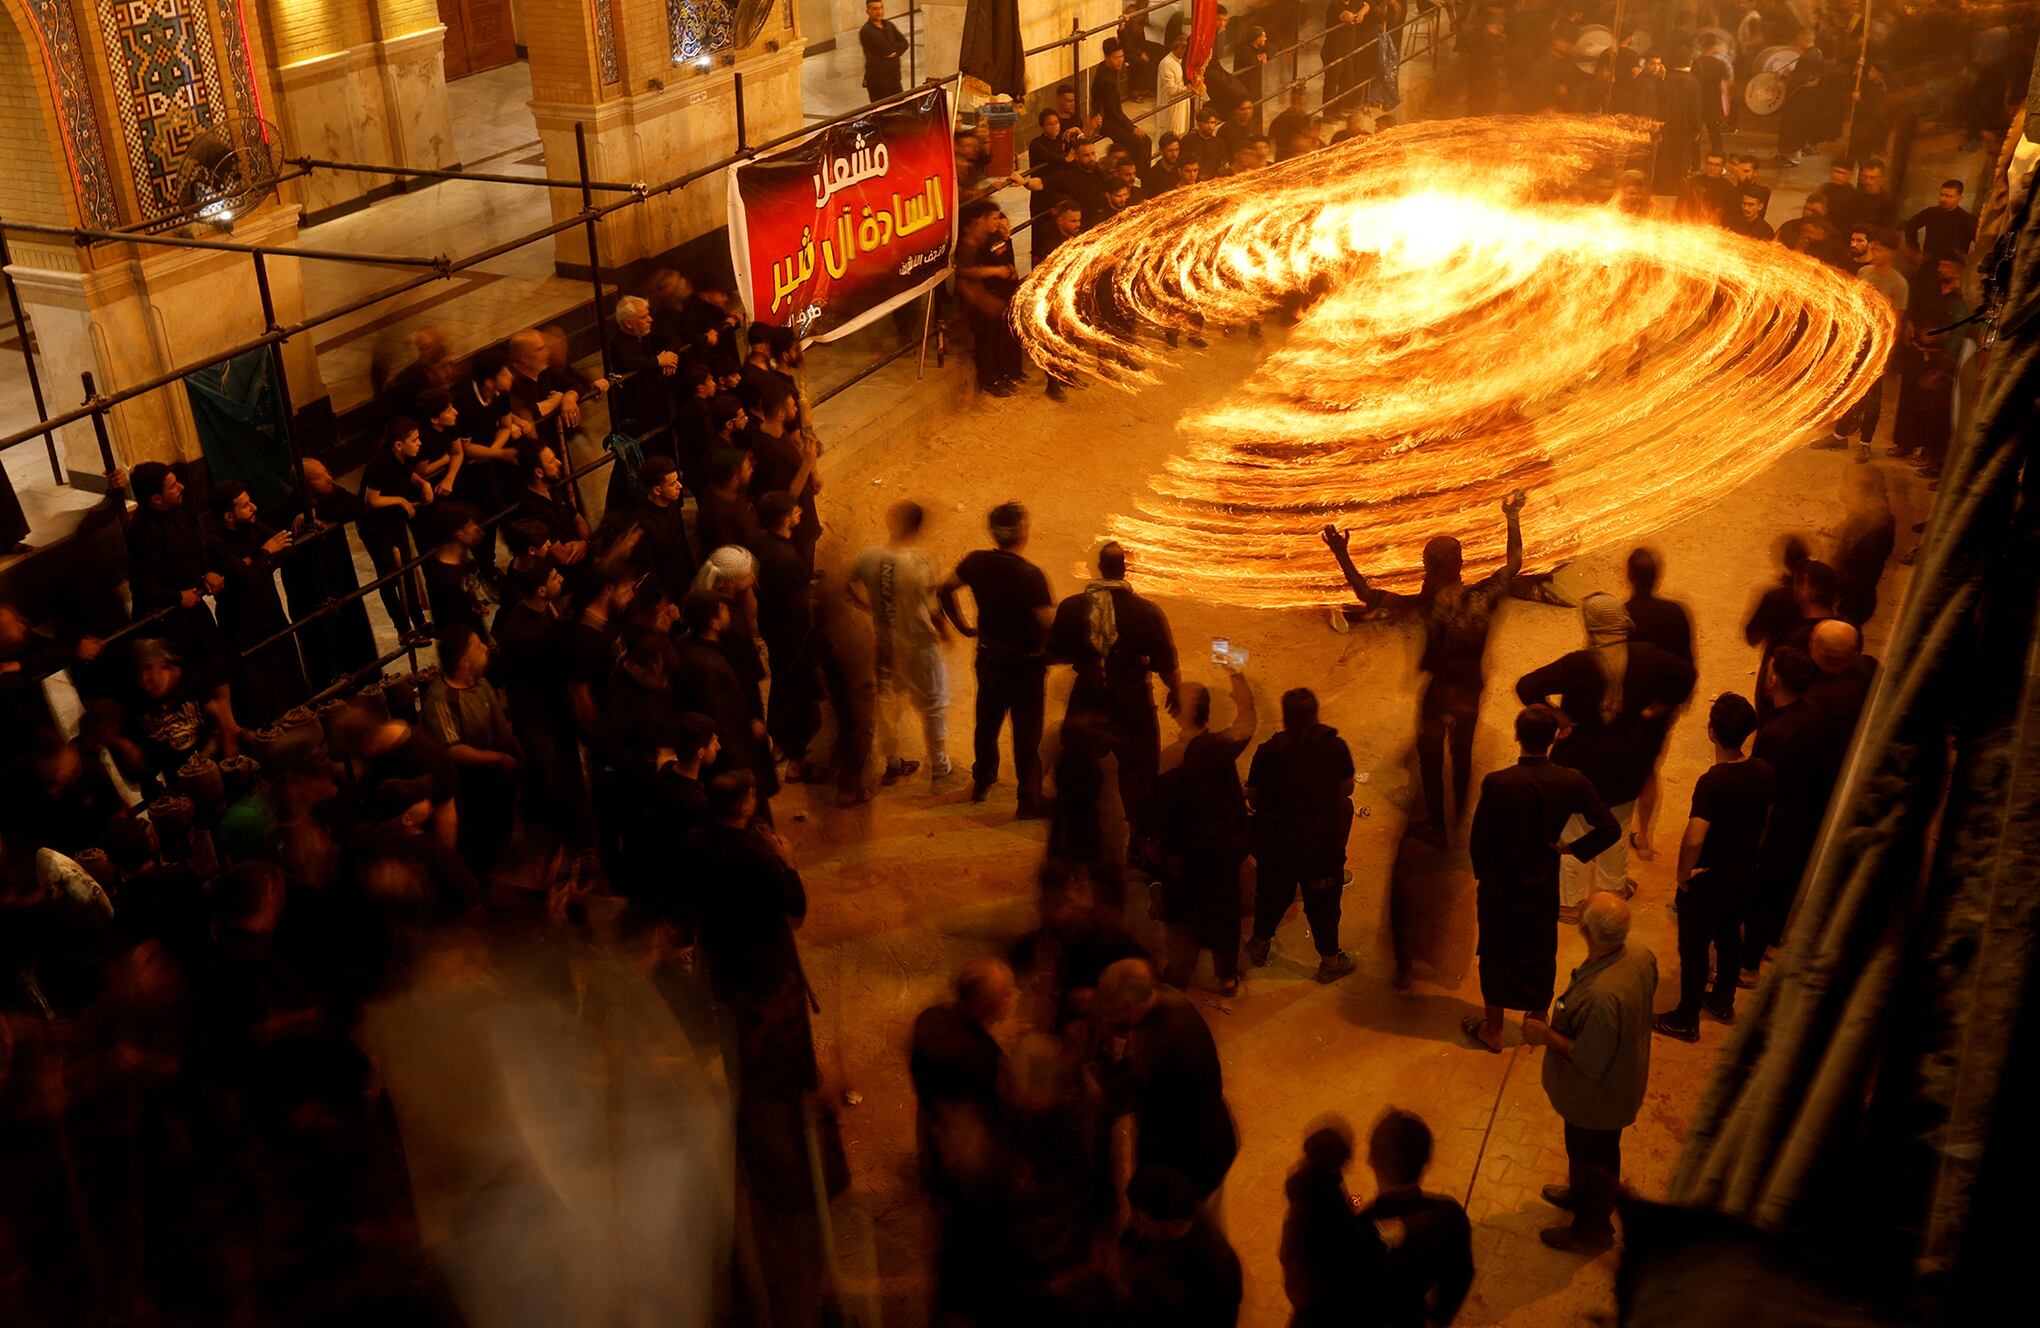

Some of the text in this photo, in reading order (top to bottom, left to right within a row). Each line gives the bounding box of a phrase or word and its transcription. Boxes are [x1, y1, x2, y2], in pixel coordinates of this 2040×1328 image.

[813, 133, 889, 209] مشعل
[771, 175, 944, 314] السادة آل شبر
